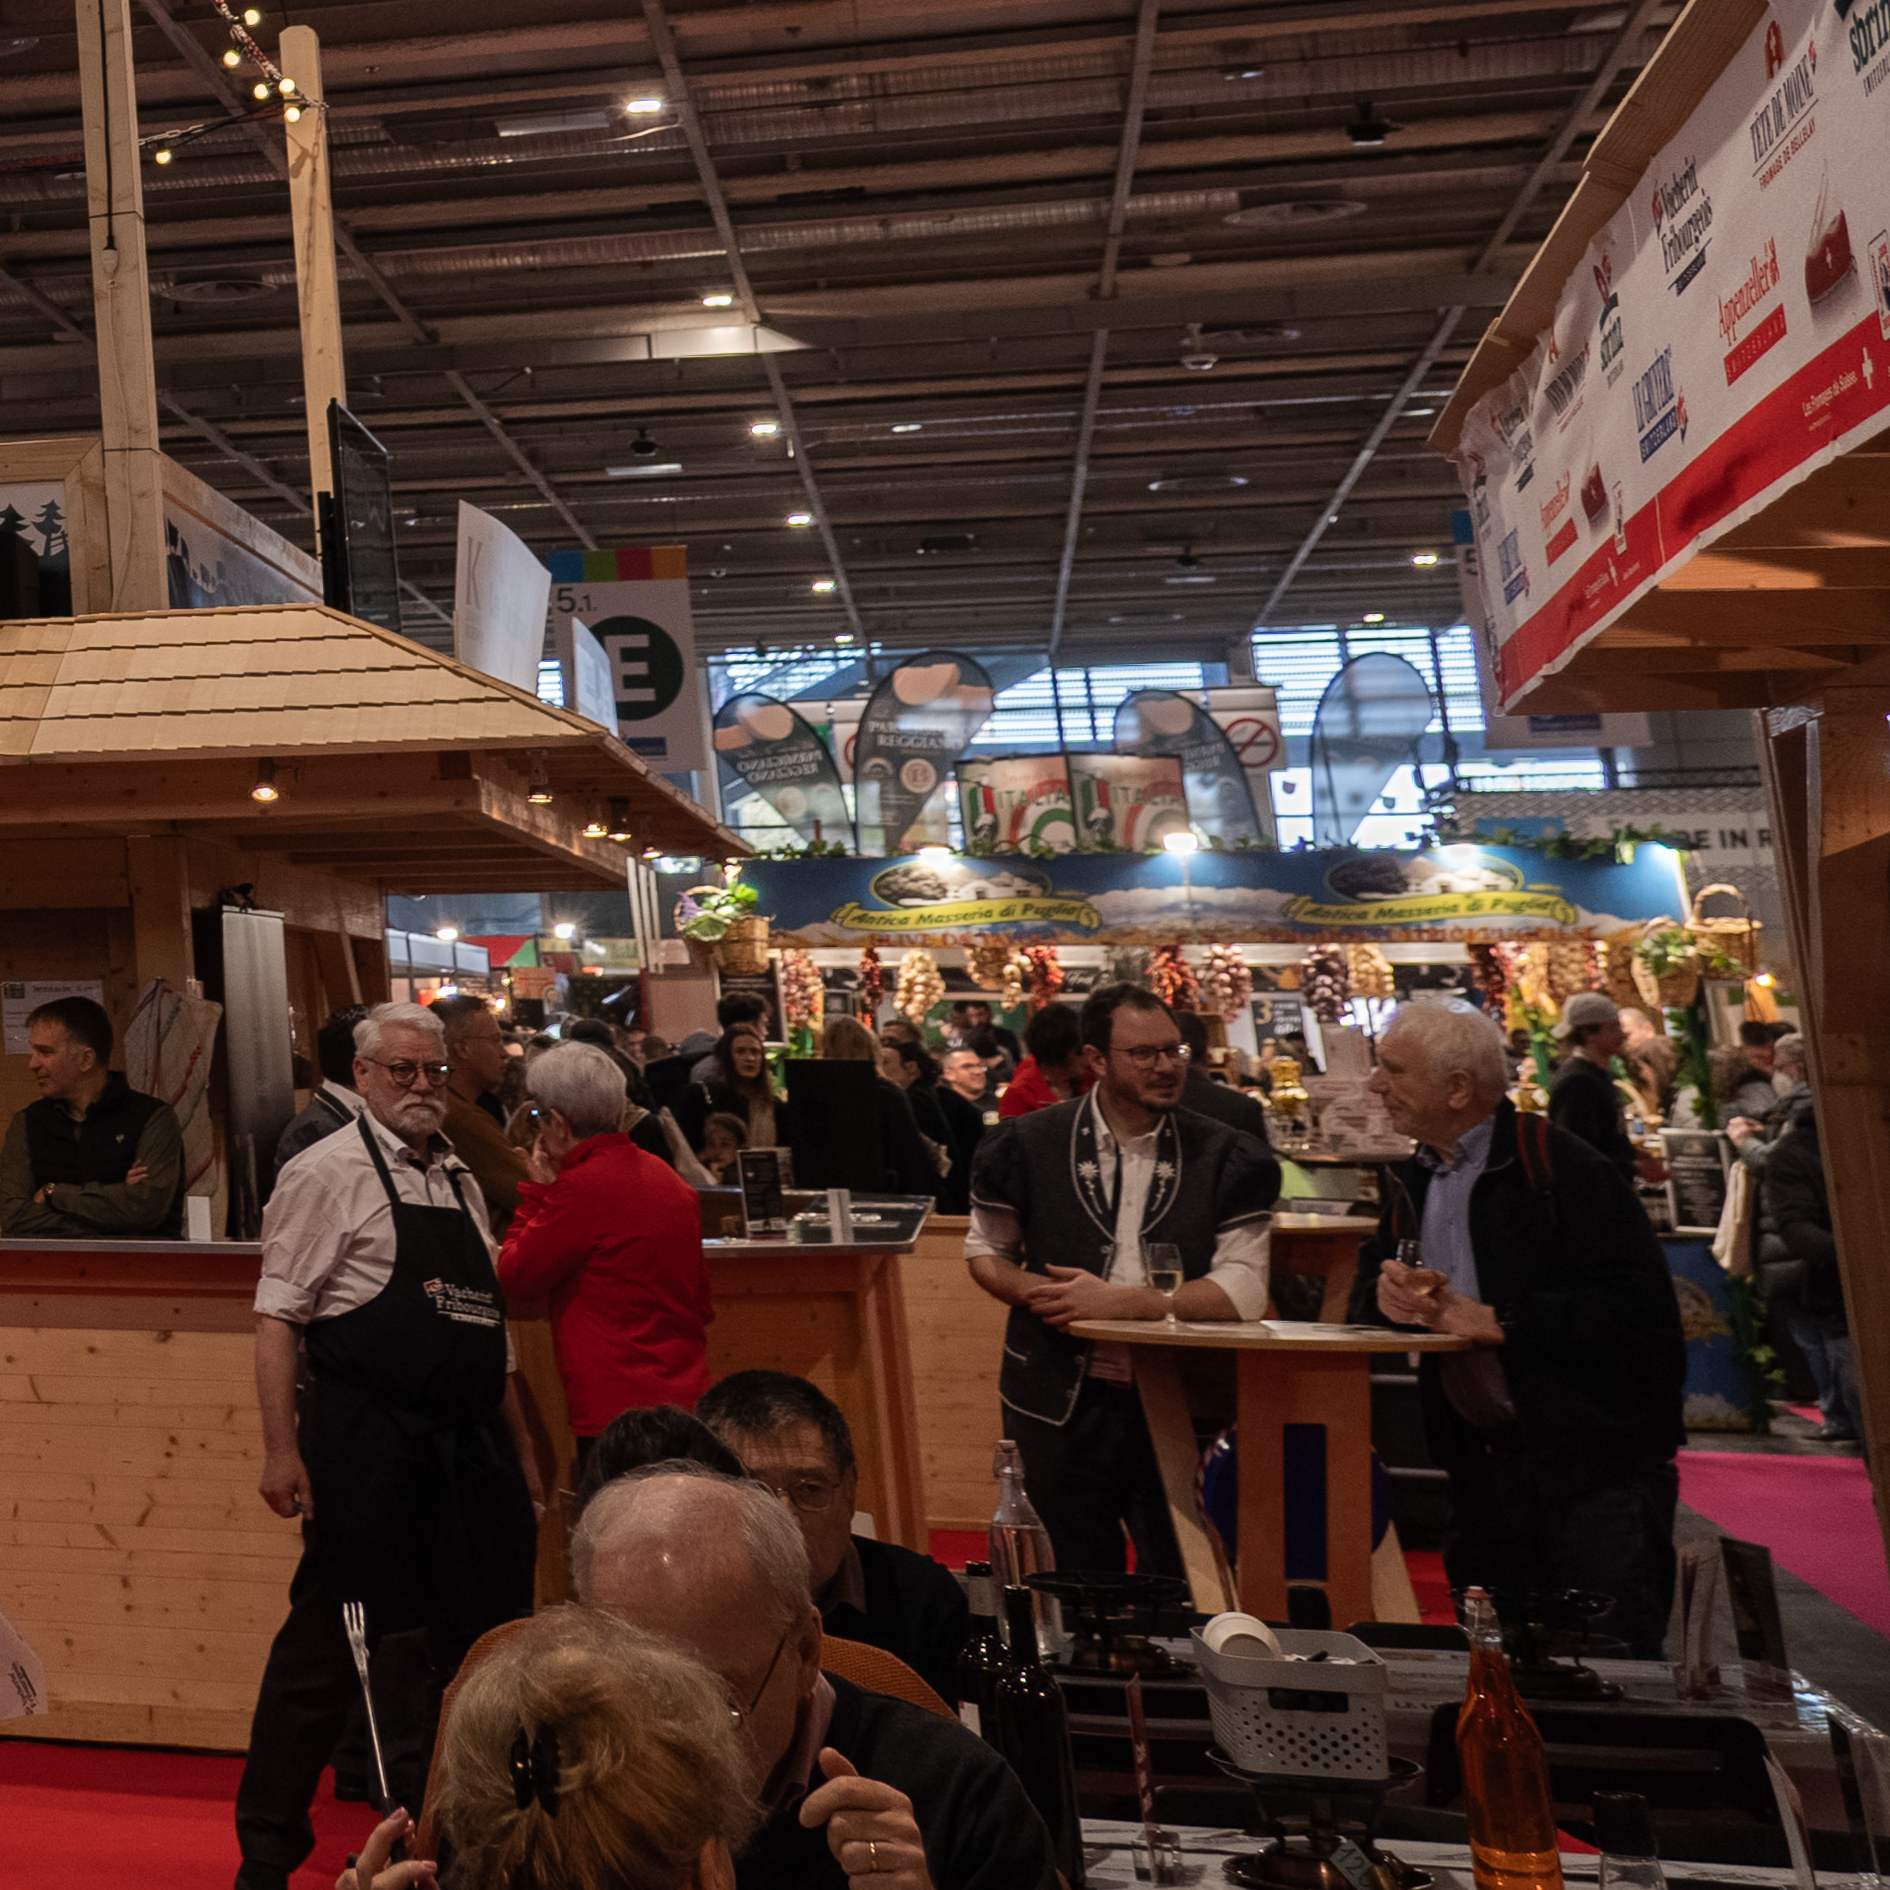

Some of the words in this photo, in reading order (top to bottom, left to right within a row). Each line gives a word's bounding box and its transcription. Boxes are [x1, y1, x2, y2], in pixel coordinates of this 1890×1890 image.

[605, 634, 657, 702] E
[851, 912, 910, 928] Antica
[918, 907, 994, 926] Masseria
